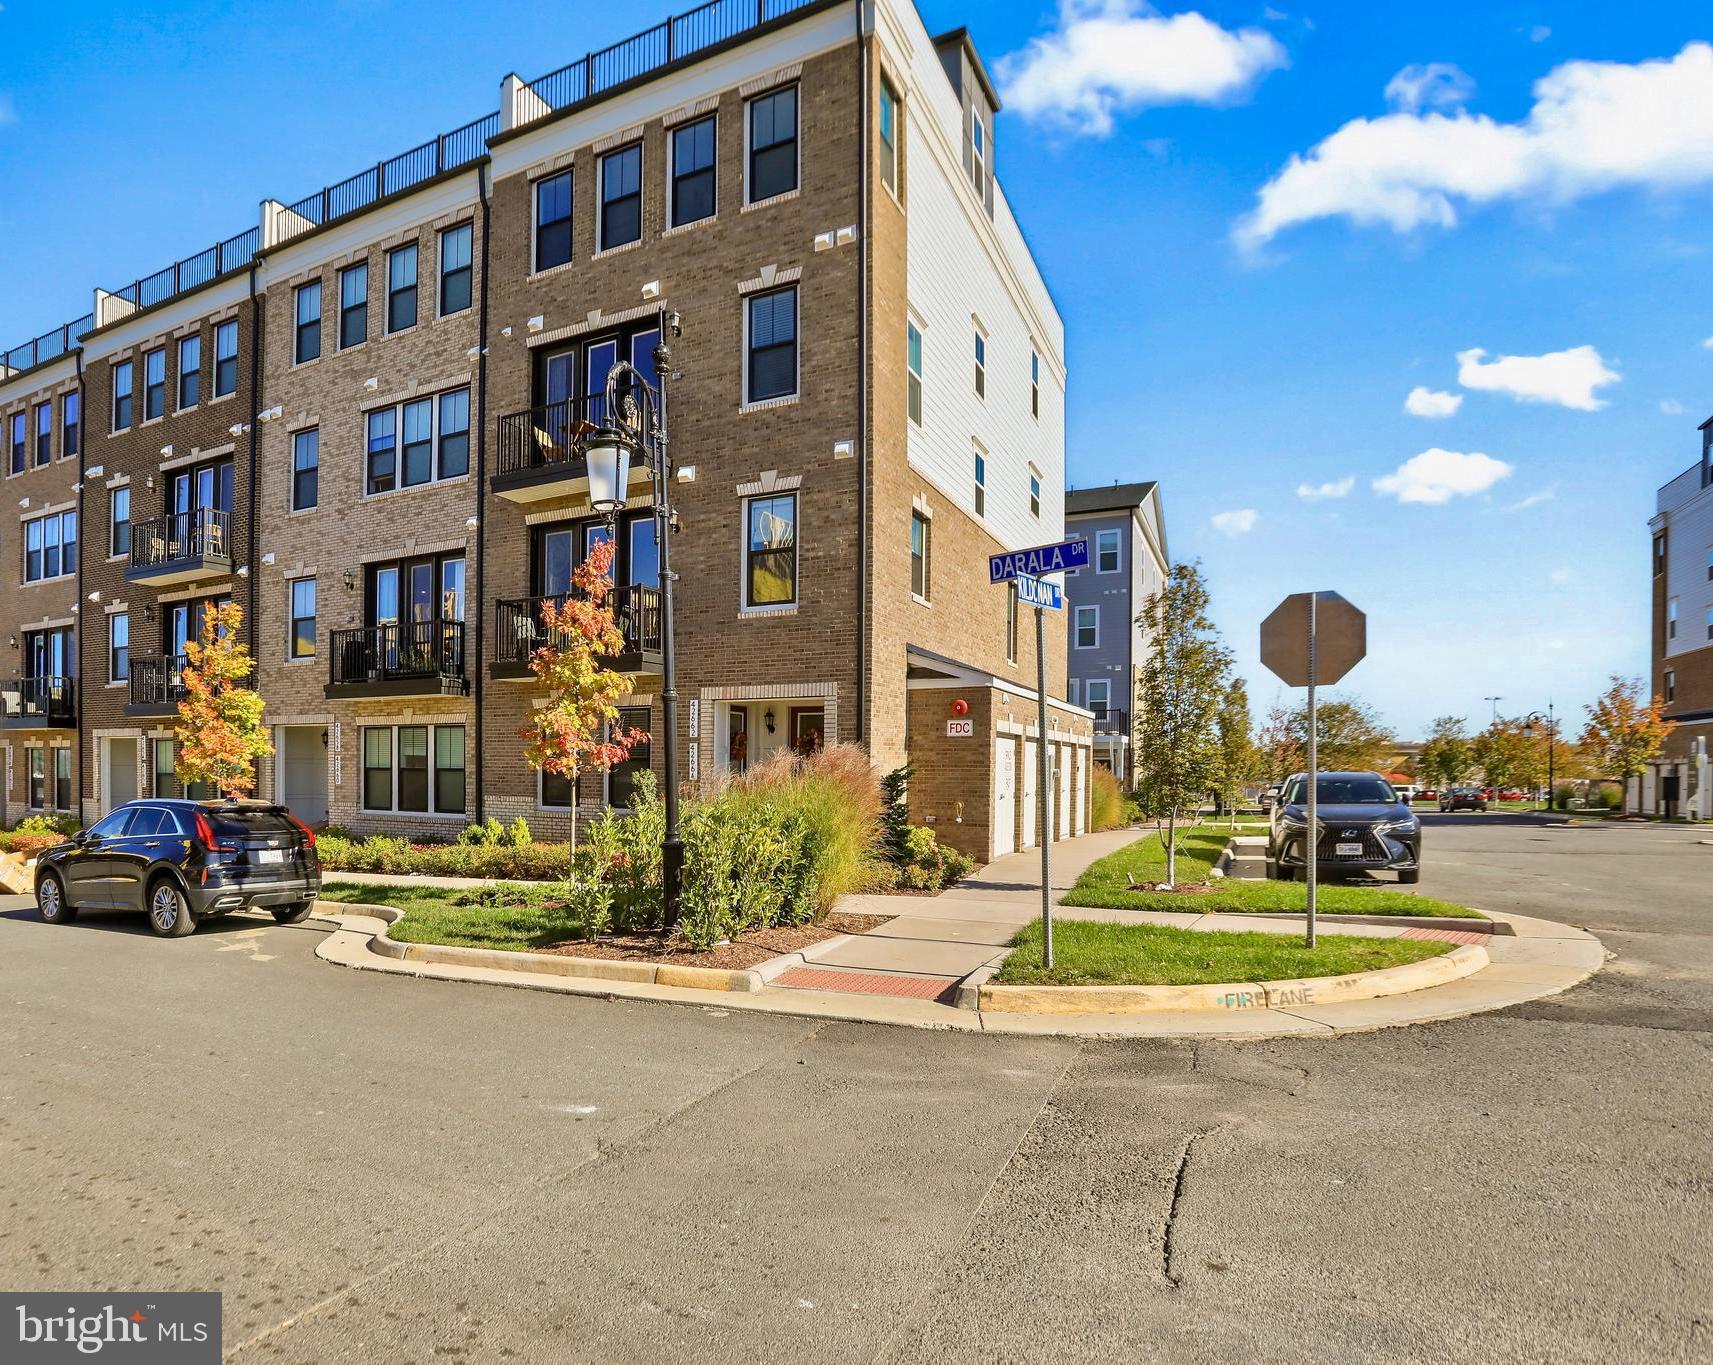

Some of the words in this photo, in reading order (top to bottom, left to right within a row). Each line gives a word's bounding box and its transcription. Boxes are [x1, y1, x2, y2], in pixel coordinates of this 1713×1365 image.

[992, 547, 1064, 580] DARALA
[1071, 542, 1085, 555] DR
[949, 722, 970, 734] FDC
[1225, 991, 1265, 1009] FIRE
